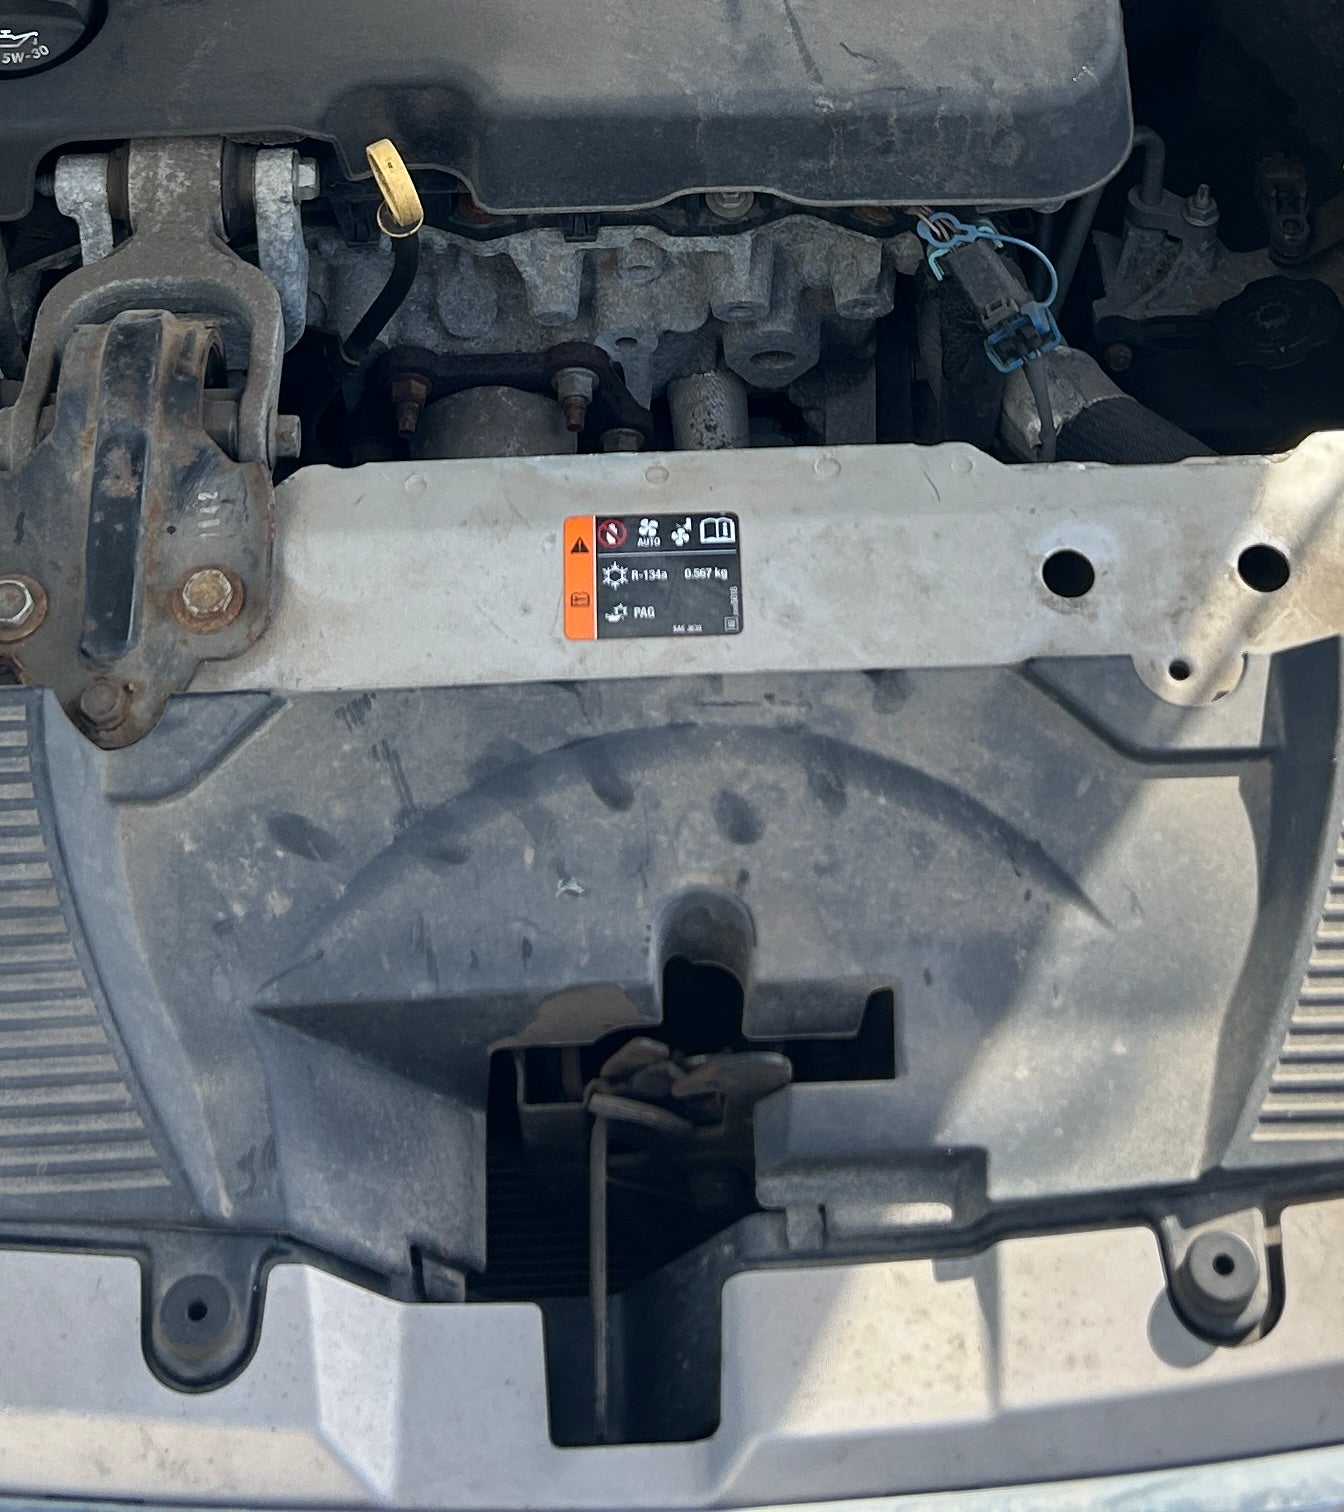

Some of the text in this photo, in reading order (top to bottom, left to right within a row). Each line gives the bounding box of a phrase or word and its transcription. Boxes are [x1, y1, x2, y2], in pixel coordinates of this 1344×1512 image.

[1, 44, 50, 64] 5W-30
[637, 536, 661, 547] AUTO
[631, 568, 668, 581] R-134a
[714, 566, 728, 581] kg
